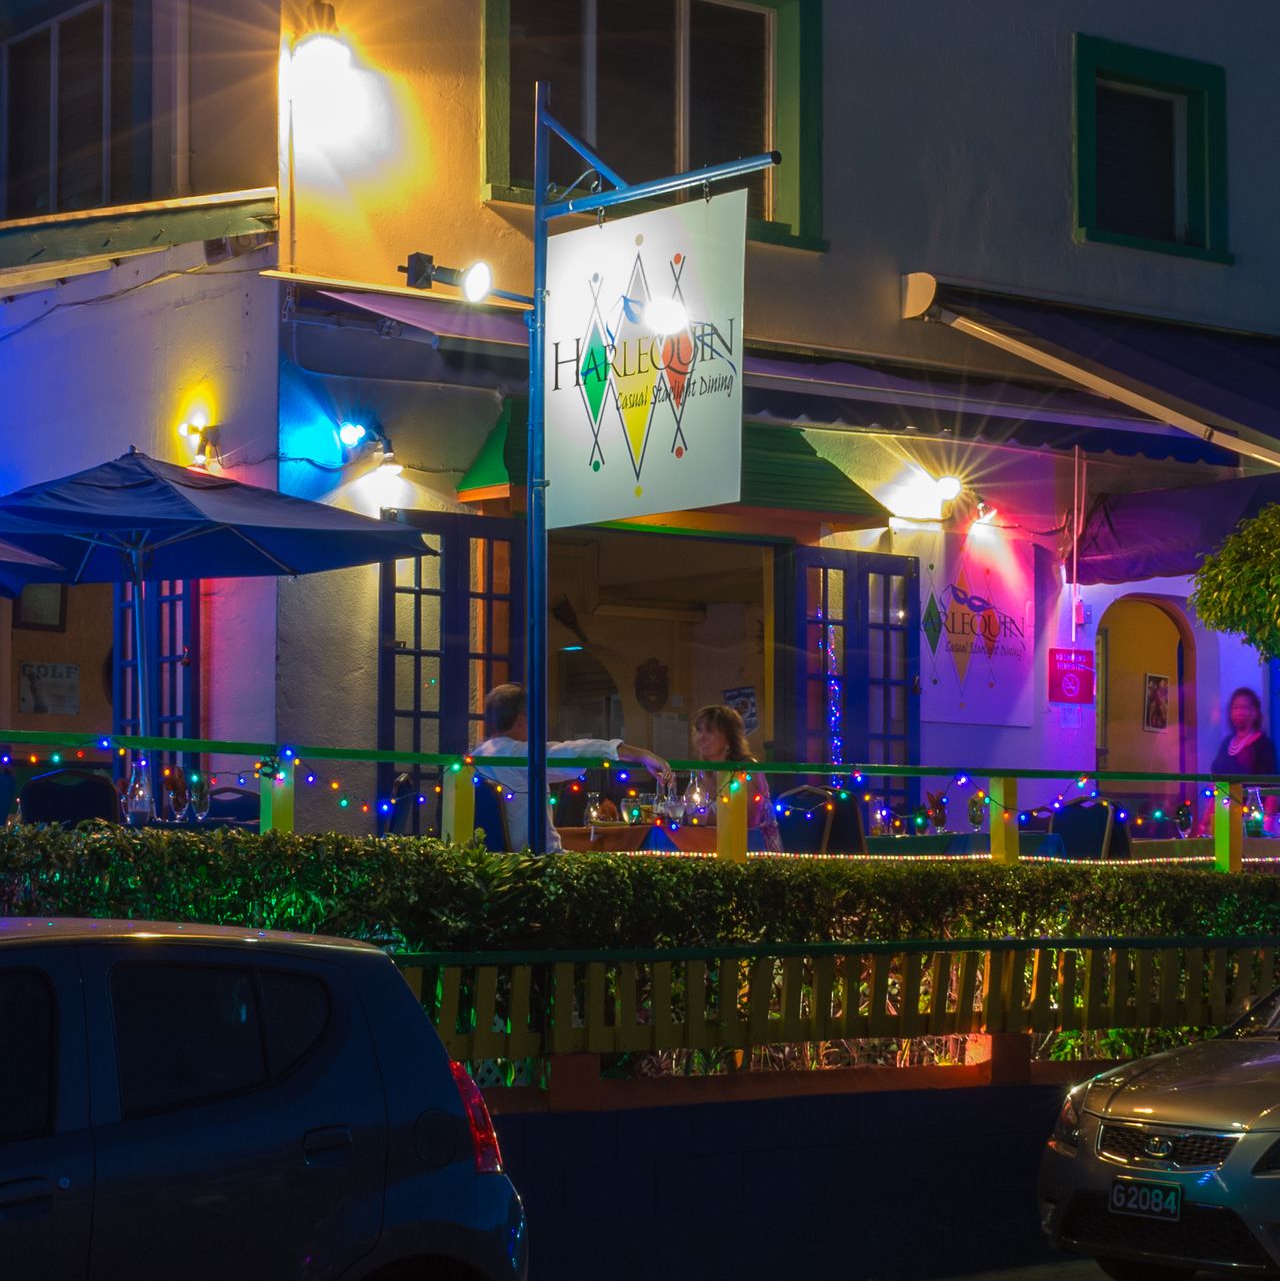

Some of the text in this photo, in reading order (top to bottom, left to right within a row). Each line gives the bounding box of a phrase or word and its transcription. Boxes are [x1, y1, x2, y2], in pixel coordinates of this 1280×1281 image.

[553, 318, 735, 390] HARLEQUIN
[616, 373, 734, 411] Casual Starlight Dining
[920, 611, 1025, 643] ARLEQUIN
[21, 663, 78, 680] GOLF
[1112, 1185, 1177, 1214] G2084
